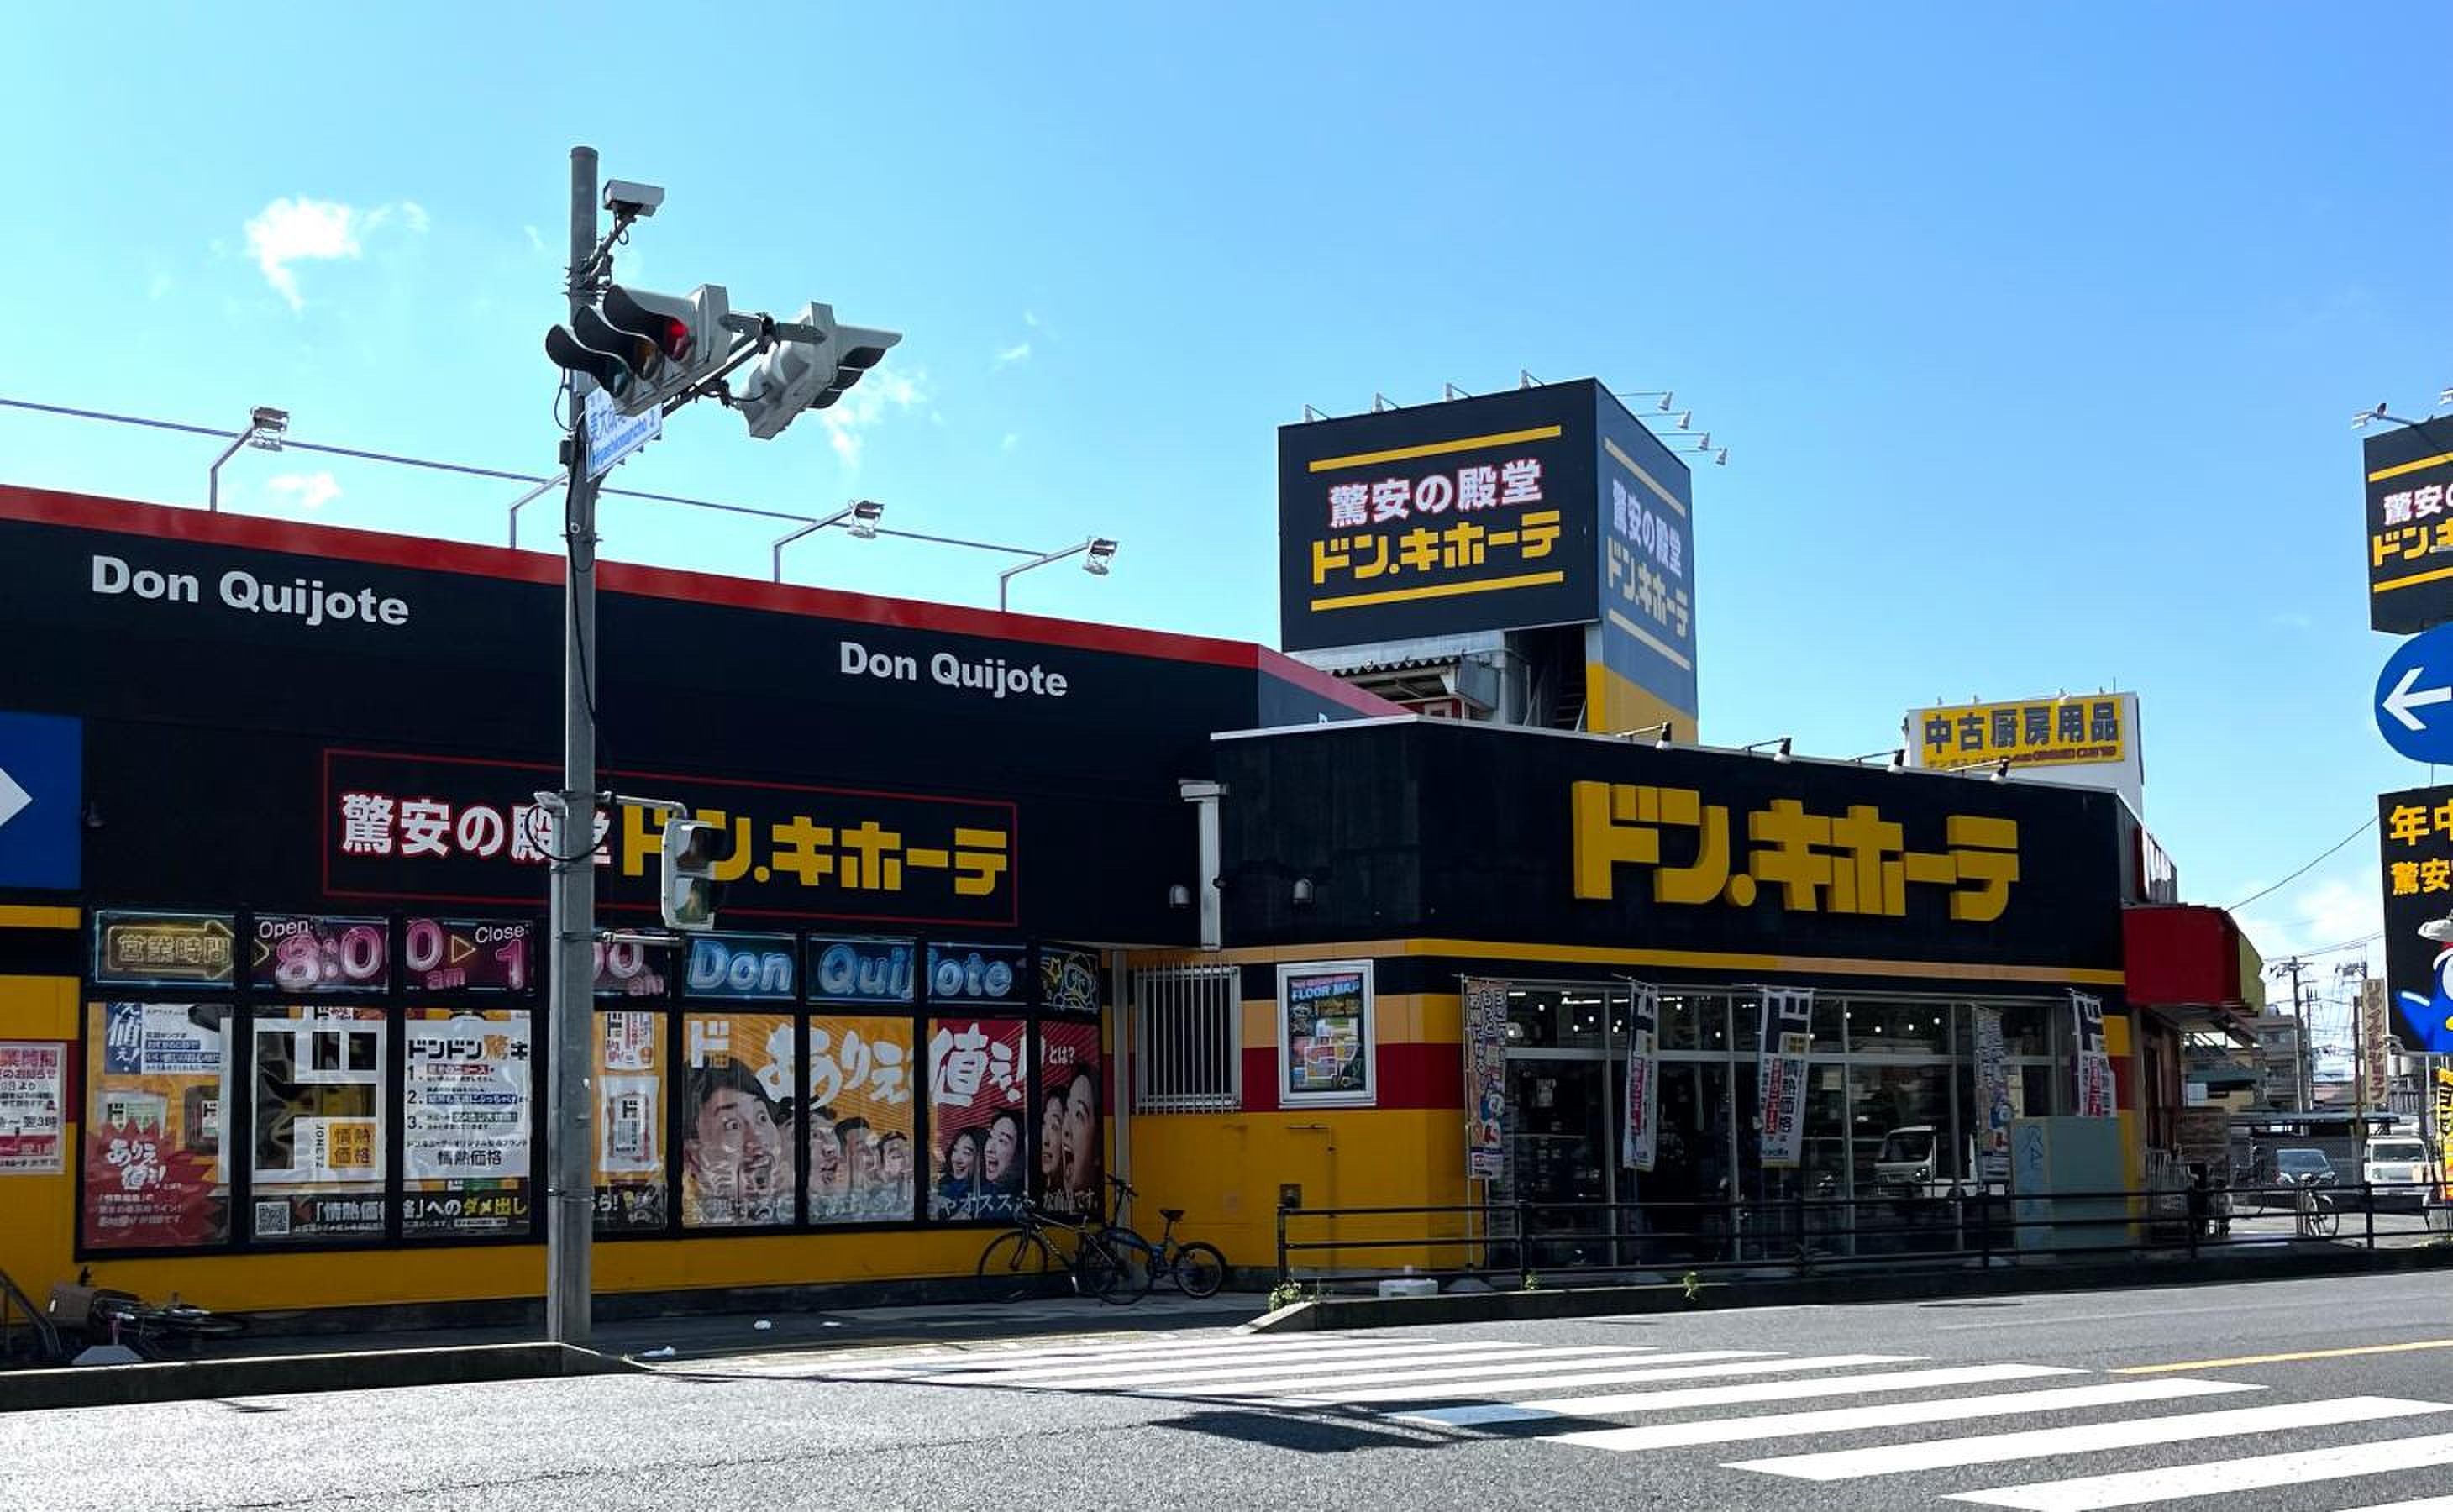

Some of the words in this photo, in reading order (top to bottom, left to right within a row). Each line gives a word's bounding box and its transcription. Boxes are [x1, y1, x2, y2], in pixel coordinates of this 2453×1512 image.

[1329, 458, 1542, 528] 驚安の殿堂
[2383, 483, 2453, 526] 驚安
[1612, 478, 1681, 579] 驚安の殿堂
[92, 554, 198, 603] Don
[219, 570, 409, 626] Quijote
[840, 642, 916, 681] Don
[931, 652, 1068, 698] Quijote
[1925, 702, 2118, 753] 中古厨房用品
[118, 934, 229, 964] 営業時間
[259, 921, 309, 939] Open
[475, 925, 525, 943] Close
[687, 938, 793, 992] Don
